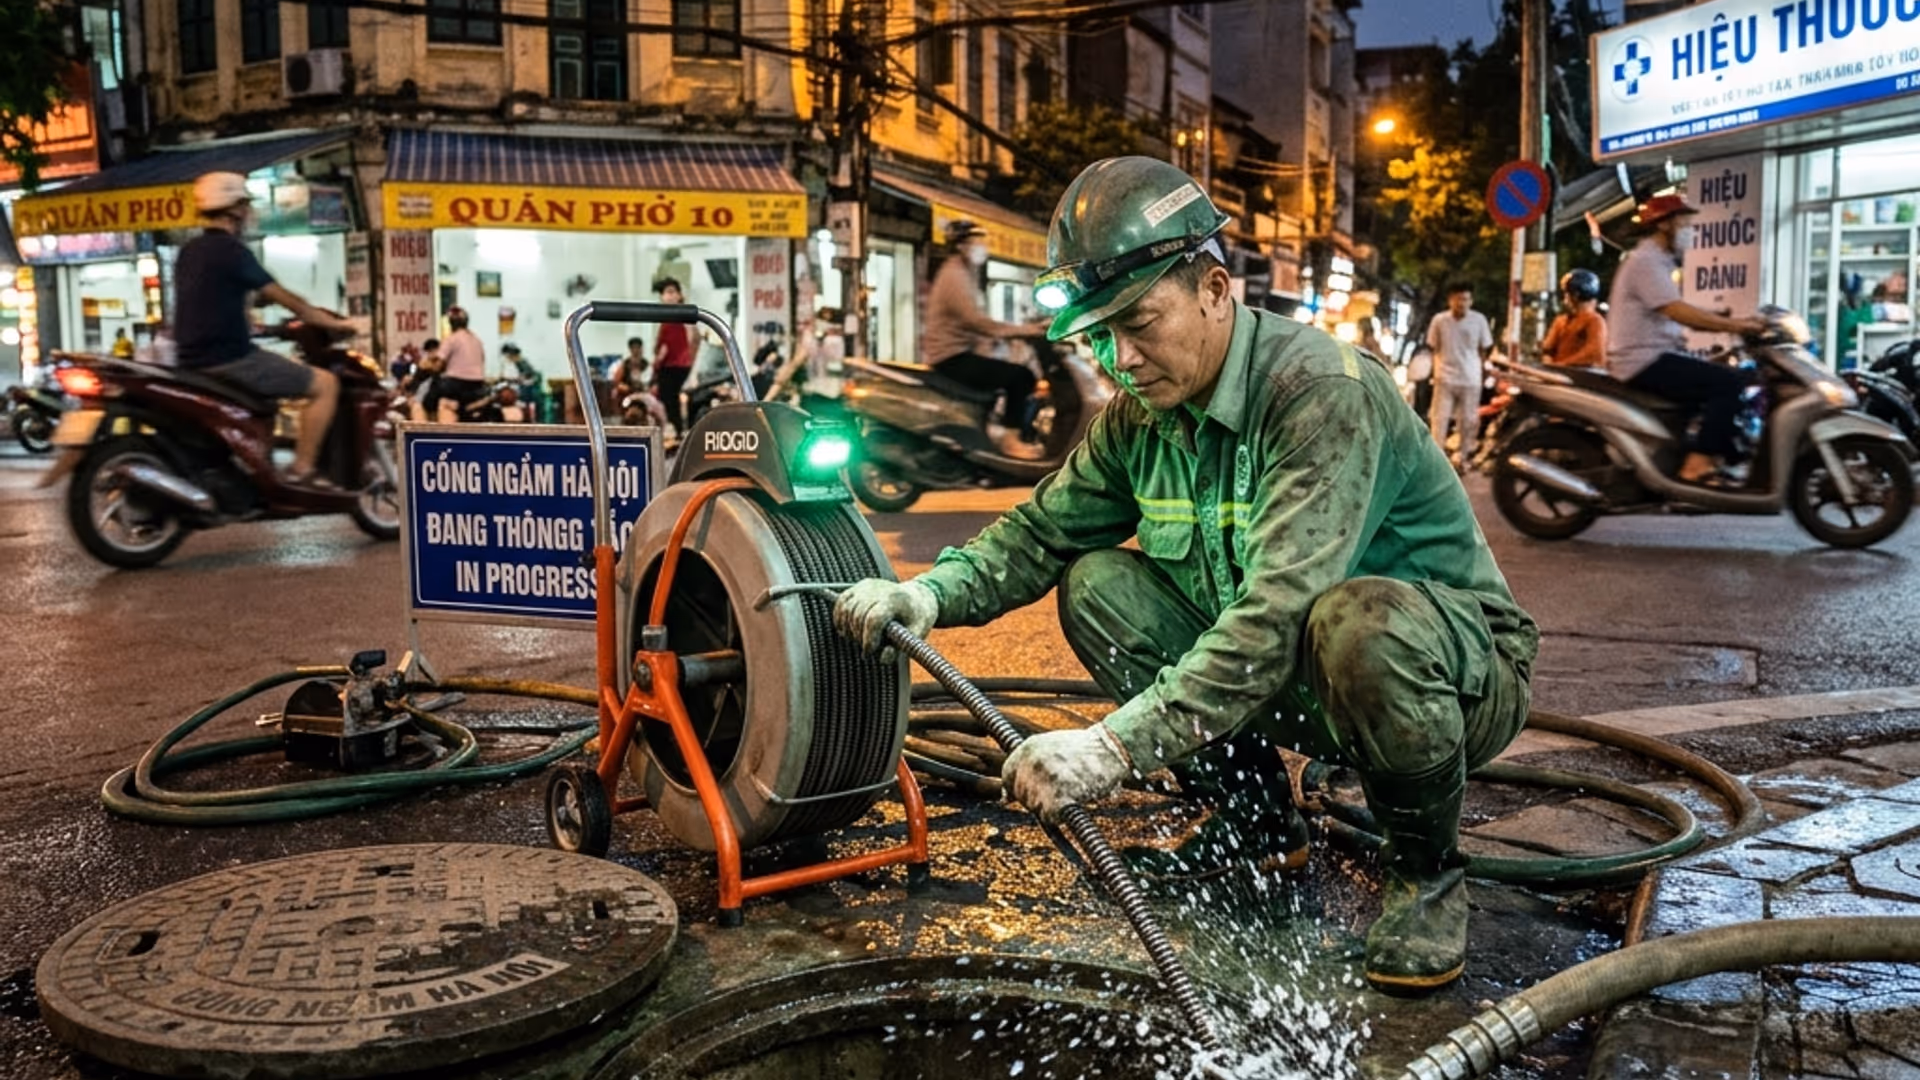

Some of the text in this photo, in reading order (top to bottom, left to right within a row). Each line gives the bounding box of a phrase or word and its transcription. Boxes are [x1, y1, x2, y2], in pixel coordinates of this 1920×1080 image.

[1672, 12, 1757, 82] HIỆU
[1772, 0, 1920, 53] THU
[690, 206, 734, 228] 10
[426, 512, 487, 547] BANG
[456, 560, 480, 594] IN
